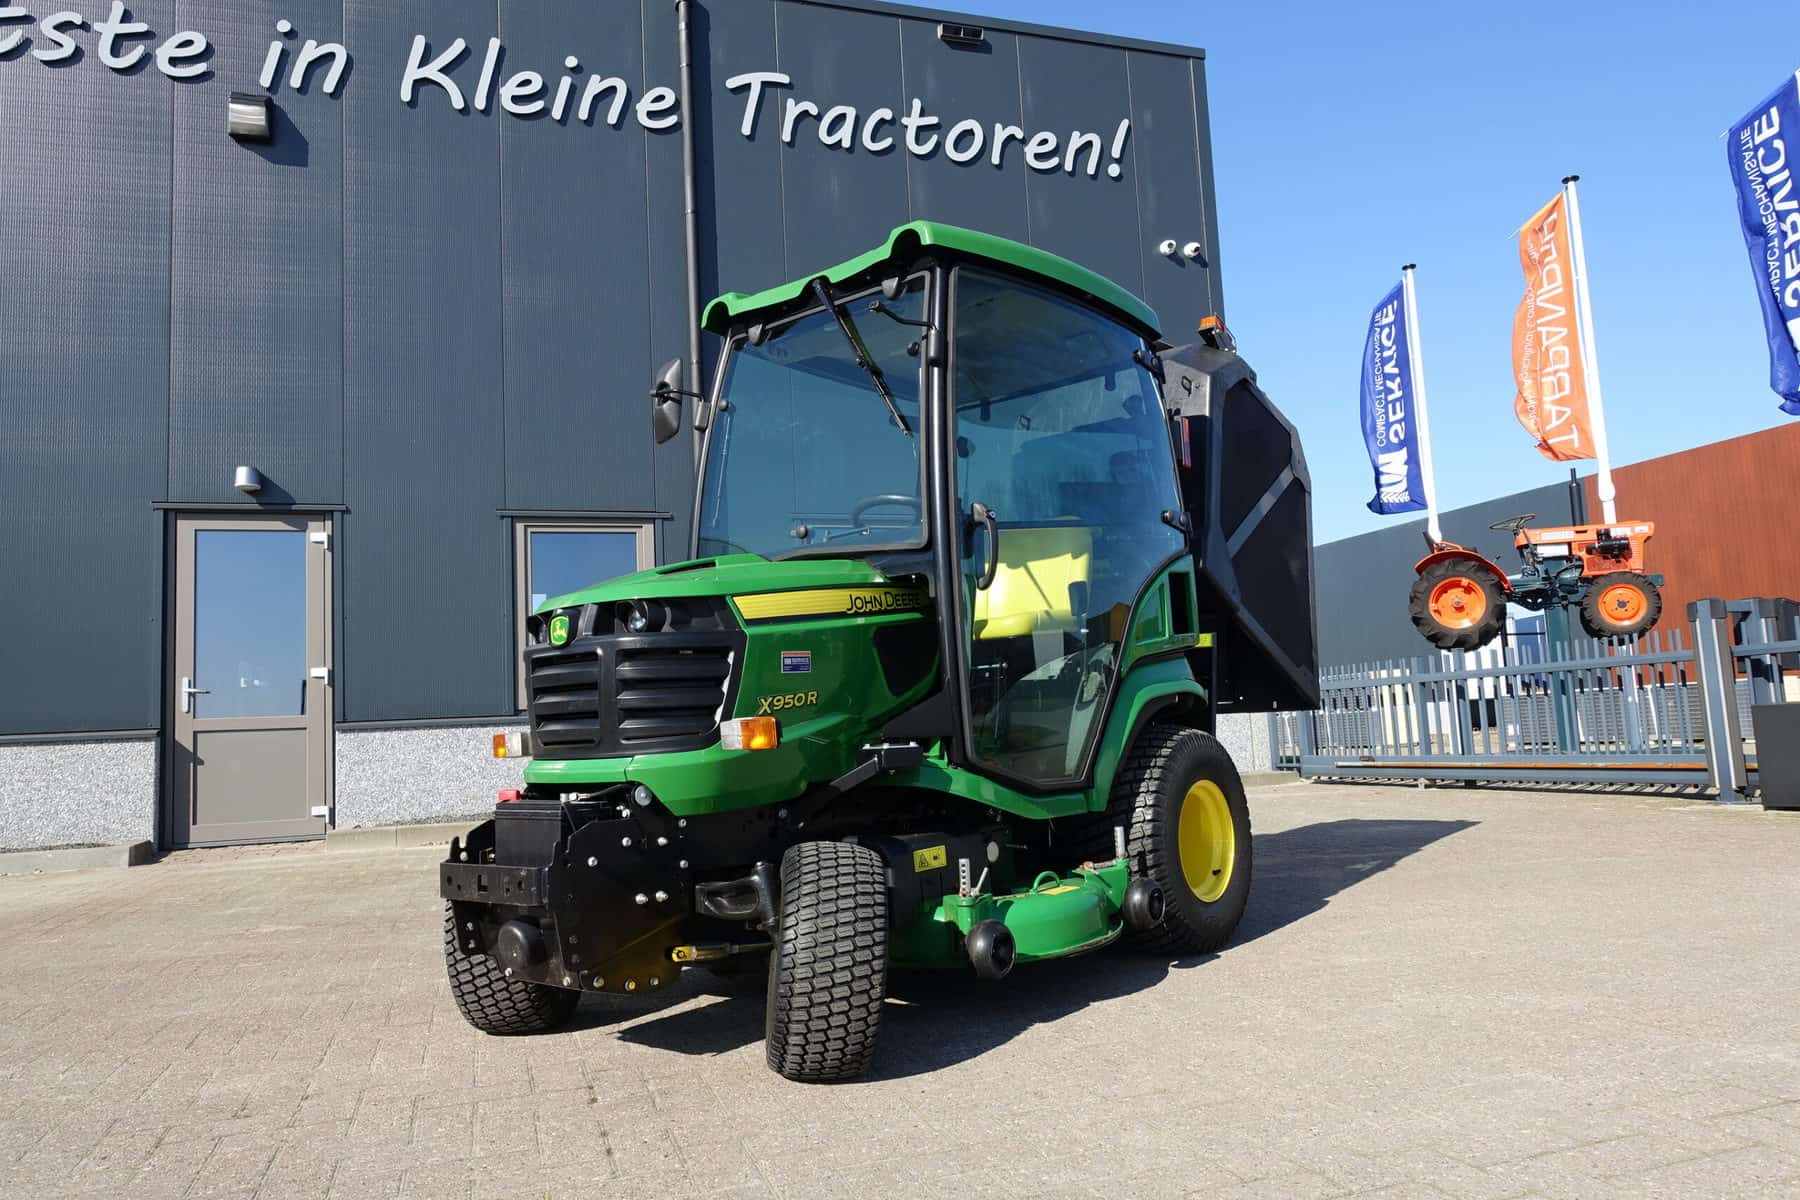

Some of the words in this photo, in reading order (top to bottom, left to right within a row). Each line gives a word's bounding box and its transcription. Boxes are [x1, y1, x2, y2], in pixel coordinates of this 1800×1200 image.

[257, 19, 349, 95] in
[400, 34, 680, 130] Kleine
[725, 71, 1131, 178] Tractoren!
[846, 593, 882, 614] JOHN
[758, 690, 818, 715] X950R
